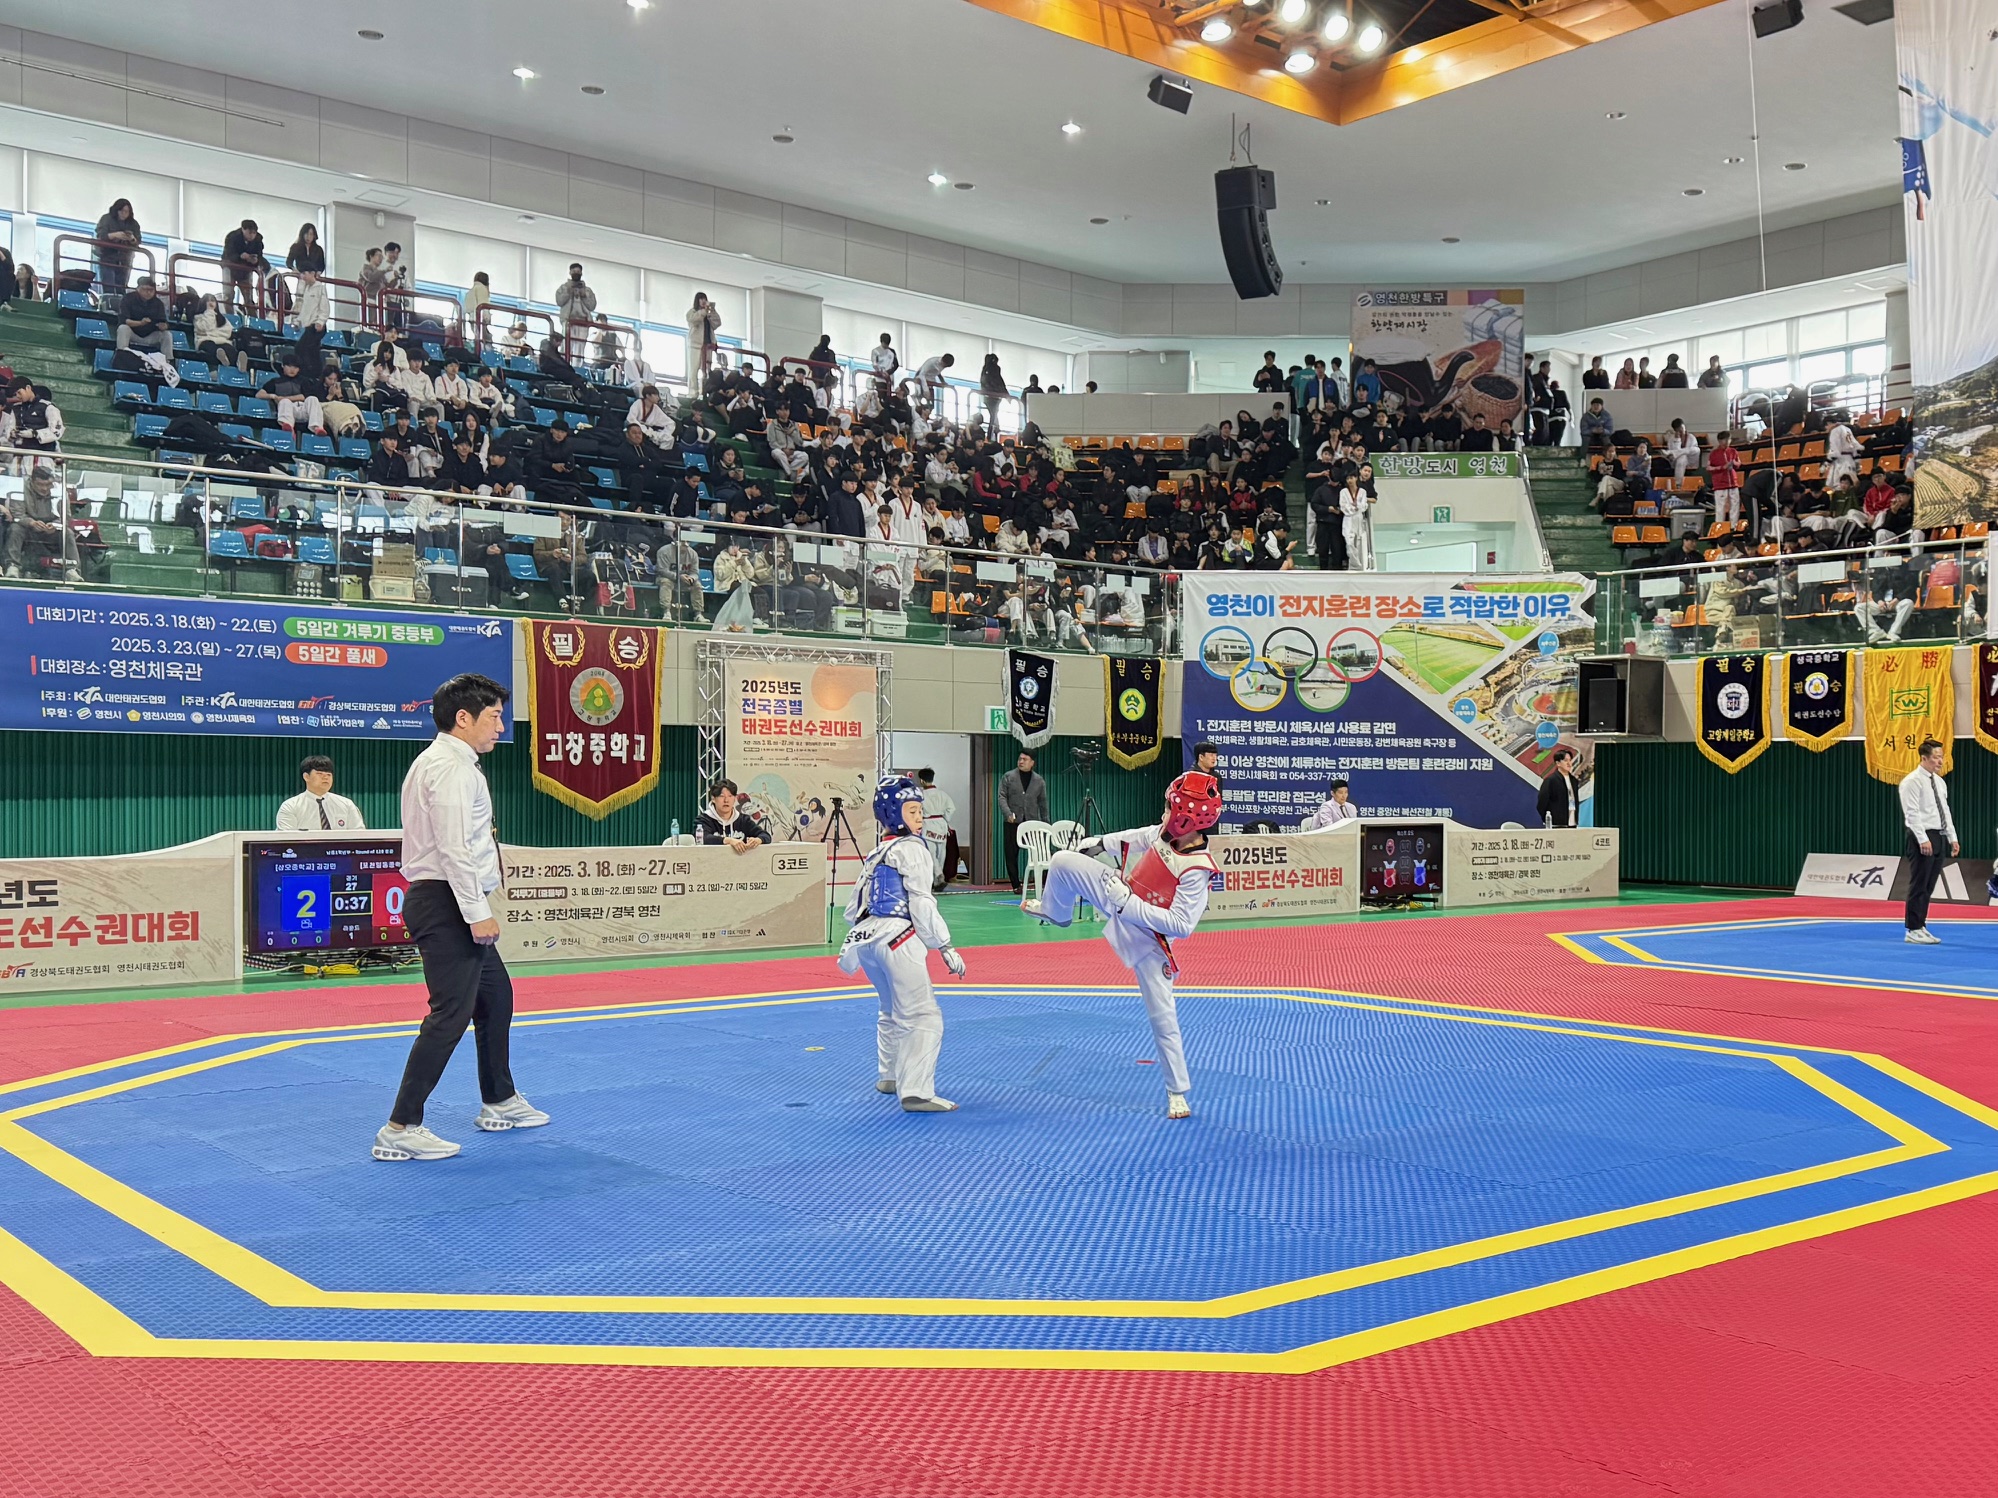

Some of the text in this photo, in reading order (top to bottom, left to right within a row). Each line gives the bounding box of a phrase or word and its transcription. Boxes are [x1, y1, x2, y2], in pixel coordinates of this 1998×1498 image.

[1375, 292, 1445, 304] 영천한방특구
[1379, 456, 1508, 475] 한방도시 영천
[1206, 594, 1571, 618] 영천이 전지훈련 장소로 적합한 이유
[36, 606, 96, 623] 대회기간
[231, 618, 277, 634] 22.(토)
[296, 620, 338, 638] 5일간
[342, 623, 387, 640] 겨루기
[391, 626, 435, 642] 중등부
[476, 620, 502, 638] KTA
[173, 641, 220, 656] 23.(일)
[236, 644, 282, 660] 27.(목)
[298, 646, 340, 663] 5일간
[346, 647, 376, 665] 품새
[108, 658, 202, 681] 영천체육관
[742, 680, 802, 695] 2025년도
[74, 686, 104, 704] KTA
[210, 692, 238, 709] KTA
[94, 710, 122, 720] 영천시
[142, 711, 186, 722] 영천시의회
[742, 698, 803, 716] 전국종별
[742, 718, 862, 738] 태권도선수권대회
[1196, 720, 1396, 734] 1. 전지훈련 방문시 체육시설 사용료 감면
[545, 732, 646, 766] 고창중학교
[1230, 756, 1254, 768] 이상
[1255, 756, 1290, 768] 영천에
[1291, 756, 1336, 769] 체류하는
[1338, 757, 1384, 770] 전지훈련
[1386, 758, 1420, 770] 방문팀
[1422, 758, 1468, 770] 훈련경비
[1470, 758, 1494, 771] 지원
[1222, 789, 1326, 804] 통팔달 편리한 접근성
[1360, 807, 1376, 816] 영천
[1377, 807, 1400, 816] 중앙선
[778, 858, 808, 870] 3코트
[1223, 846, 1288, 866] 2025년도
[506, 866, 534, 878] 기간
[544, 865, 574, 878] 2025.
[578, 861, 590, 878] 3.
[596, 860, 614, 877] 18.
[648, 860, 670, 876] 27.
[1846, 866, 1884, 888] KTA
[346, 882, 358, 891] 27
[296, 886, 405, 918] 2 0:37 0
[506, 904, 661, 922] 장소 영천체육관 경북 영천
[30, 960, 185, 978] 경상북도태권도협회 영천시태권도협회
